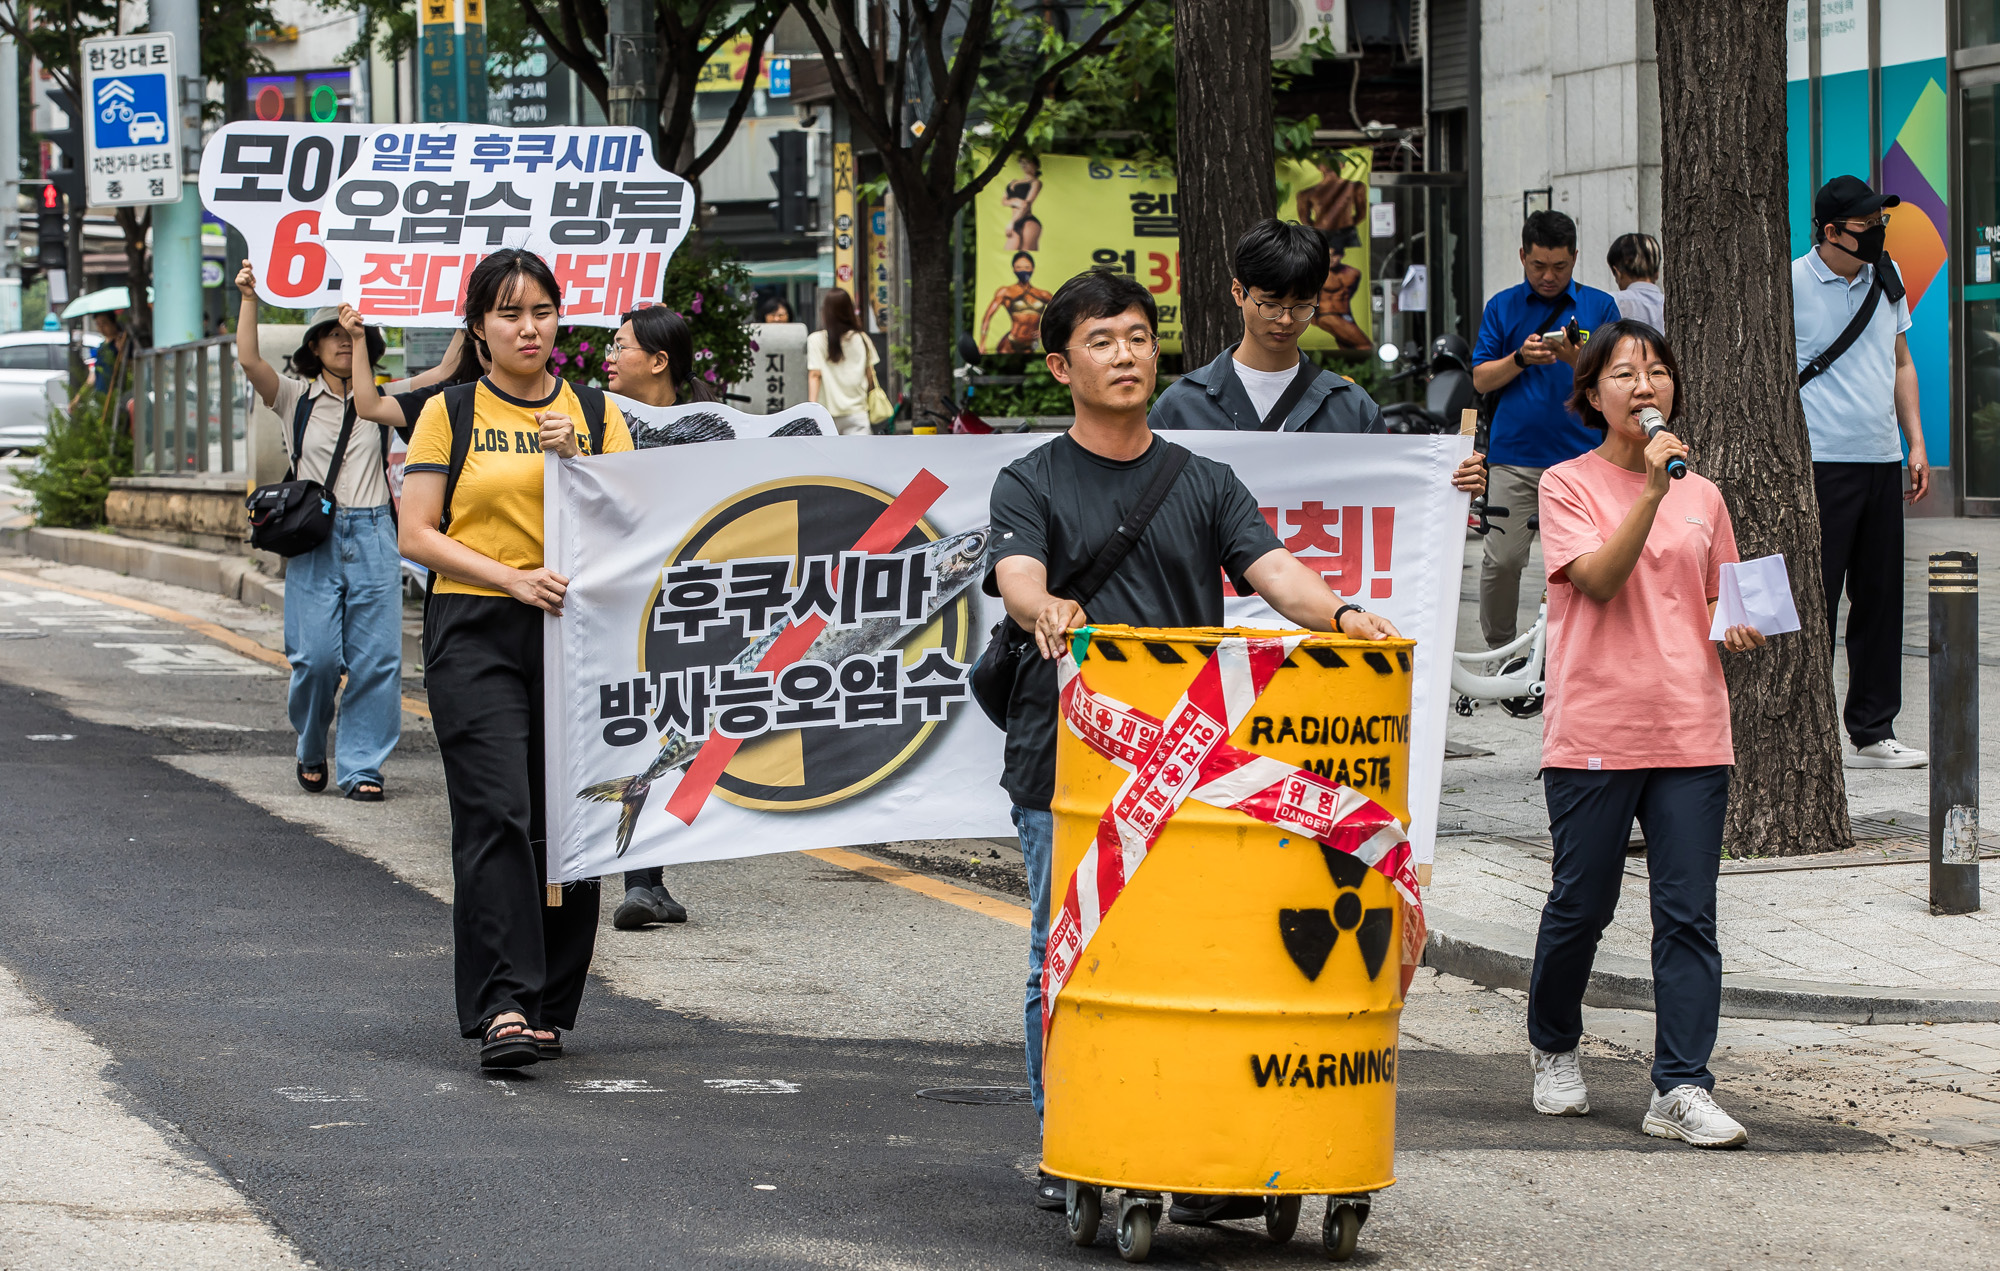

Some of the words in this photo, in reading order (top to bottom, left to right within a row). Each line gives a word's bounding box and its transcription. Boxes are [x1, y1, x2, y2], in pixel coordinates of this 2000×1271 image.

[89, 44, 168, 72] 한강대로
[214, 134, 369, 202] 모이
[372, 133, 457, 172] 일본
[470, 134, 644, 173] 후쿠시마
[326, 179, 532, 246] 오염수
[549, 180, 685, 245] 방류
[474, 428, 509, 452] LOS
[658, 551, 938, 642] 후쿠시마
[599, 648, 968, 746] 방사능오염수
[1175, 722, 1215, 767] 안전
[1250, 714, 1409, 746] RADIOACTIVE
[1303, 756, 1391, 790] WASTE
[1280, 806, 1329, 832] DANGER
[1250, 1045, 1396, 1089] WARNING!
